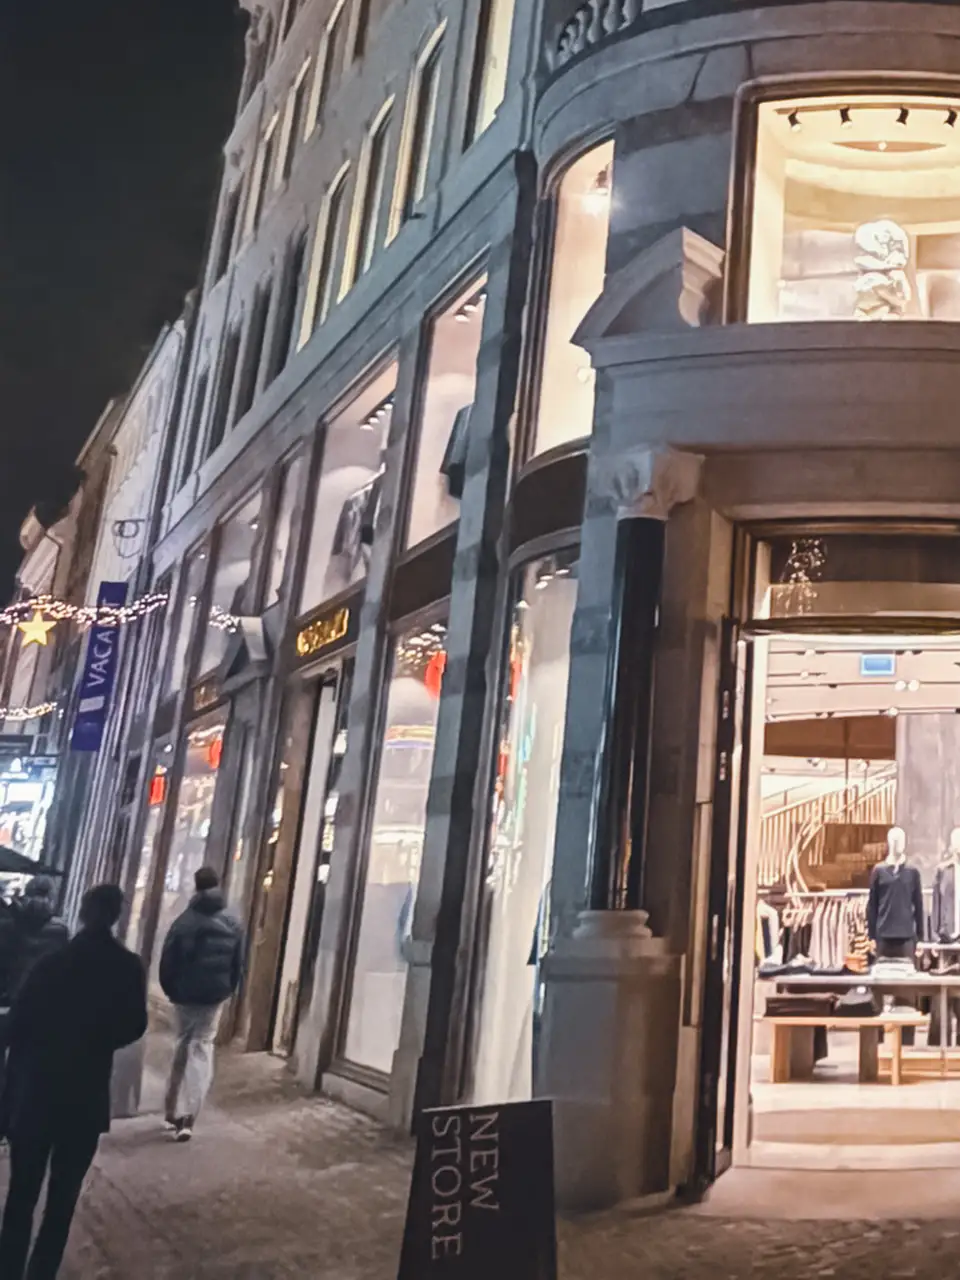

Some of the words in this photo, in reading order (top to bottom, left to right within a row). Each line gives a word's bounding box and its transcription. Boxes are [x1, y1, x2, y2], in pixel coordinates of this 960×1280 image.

[87, 598, 121, 688] VACAT
[431, 1115, 463, 1260] STORE
[469, 1111, 499, 1210] NEW
